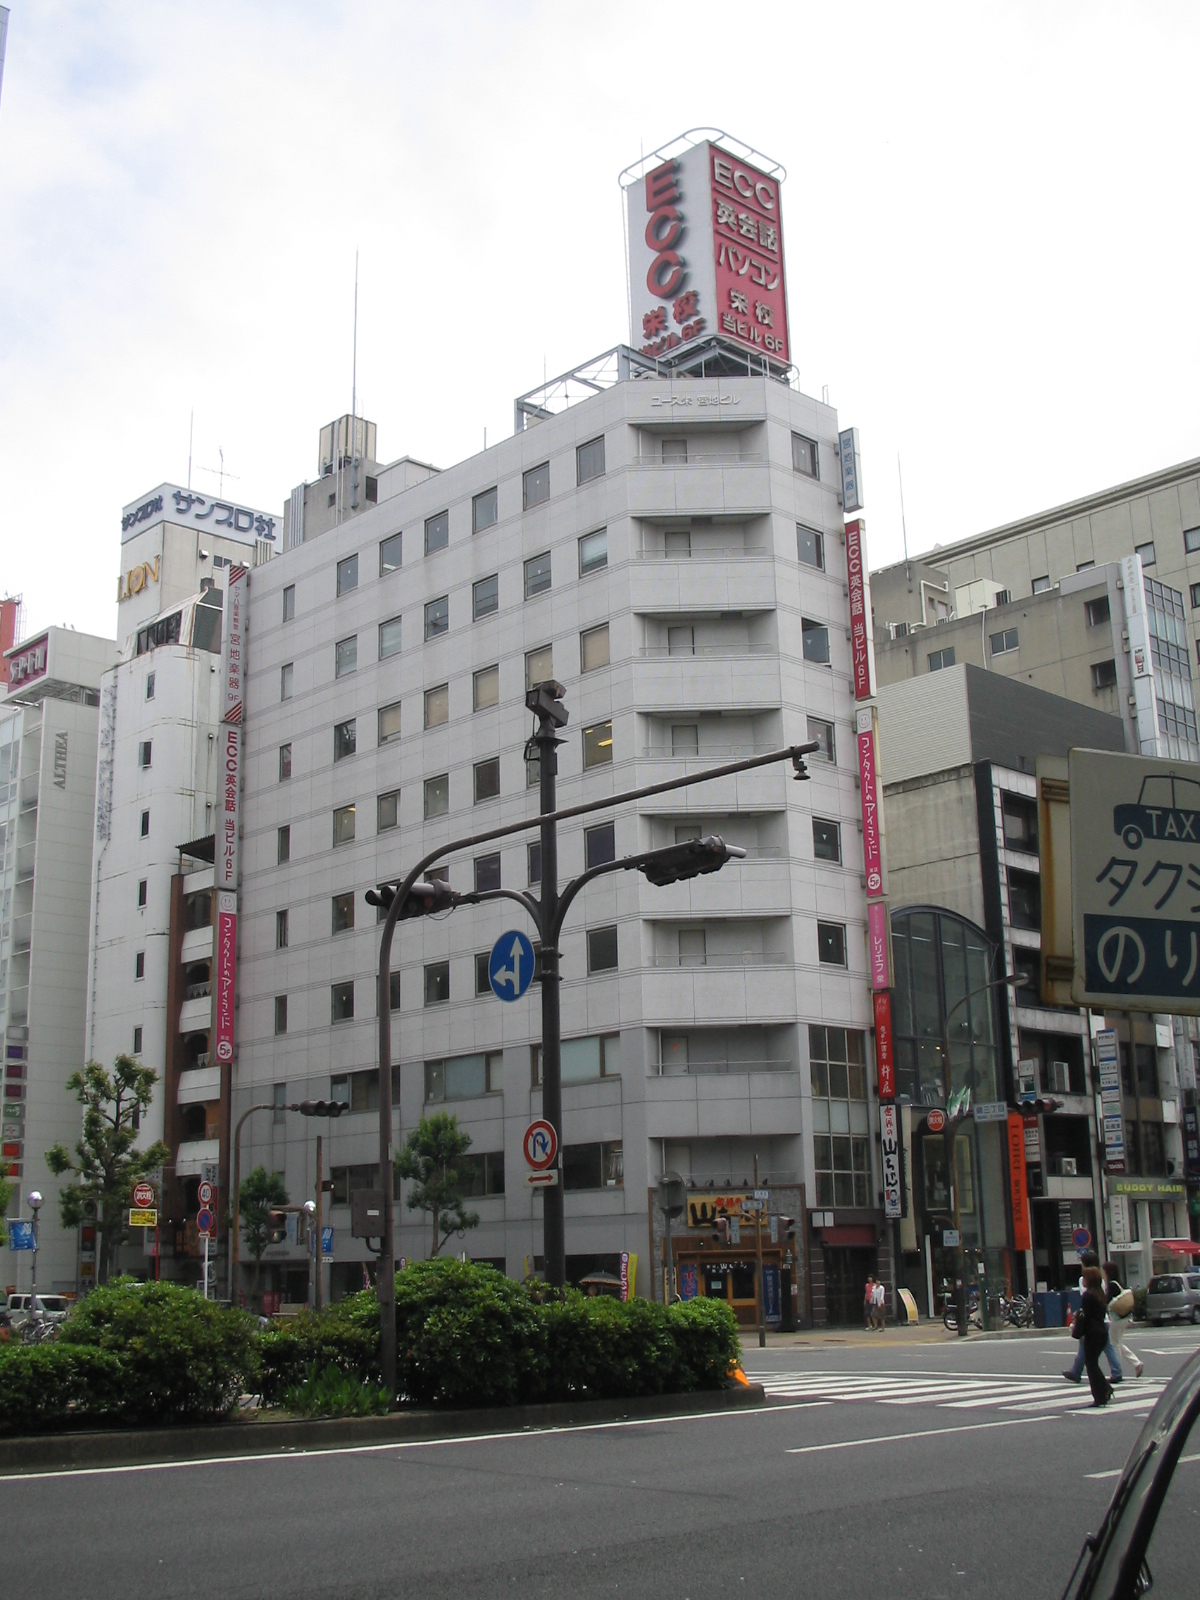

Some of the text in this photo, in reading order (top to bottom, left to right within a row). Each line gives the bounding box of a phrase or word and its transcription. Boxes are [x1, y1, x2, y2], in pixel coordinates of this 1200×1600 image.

[712, 155, 776, 210] ECC
[645, 157, 684, 299] ECC
[715, 199, 778, 253] 英会話
[718, 242, 780, 291] パソコン
[722, 311, 784, 353] 当ビル6F
[116, 554, 161, 602] LION
[848, 532, 867, 690] ECC英会話 当ビル6F
[228, 633, 241, 690] 宮地楽器
[223, 731, 238, 881] ECC英会話 当ビル6F
[862, 737, 878, 860] コンタクトのアイランド
[870, 876, 880, 887] 5F
[221, 917, 232, 1030] コンタクトのアイランド
[874, 936, 885, 973] レリエフ
[219, 1043, 231, 1057] 5F
[202, 1188, 210, 1198] 40
[1116, 1183, 1183, 1193] BUDDY HAIR
